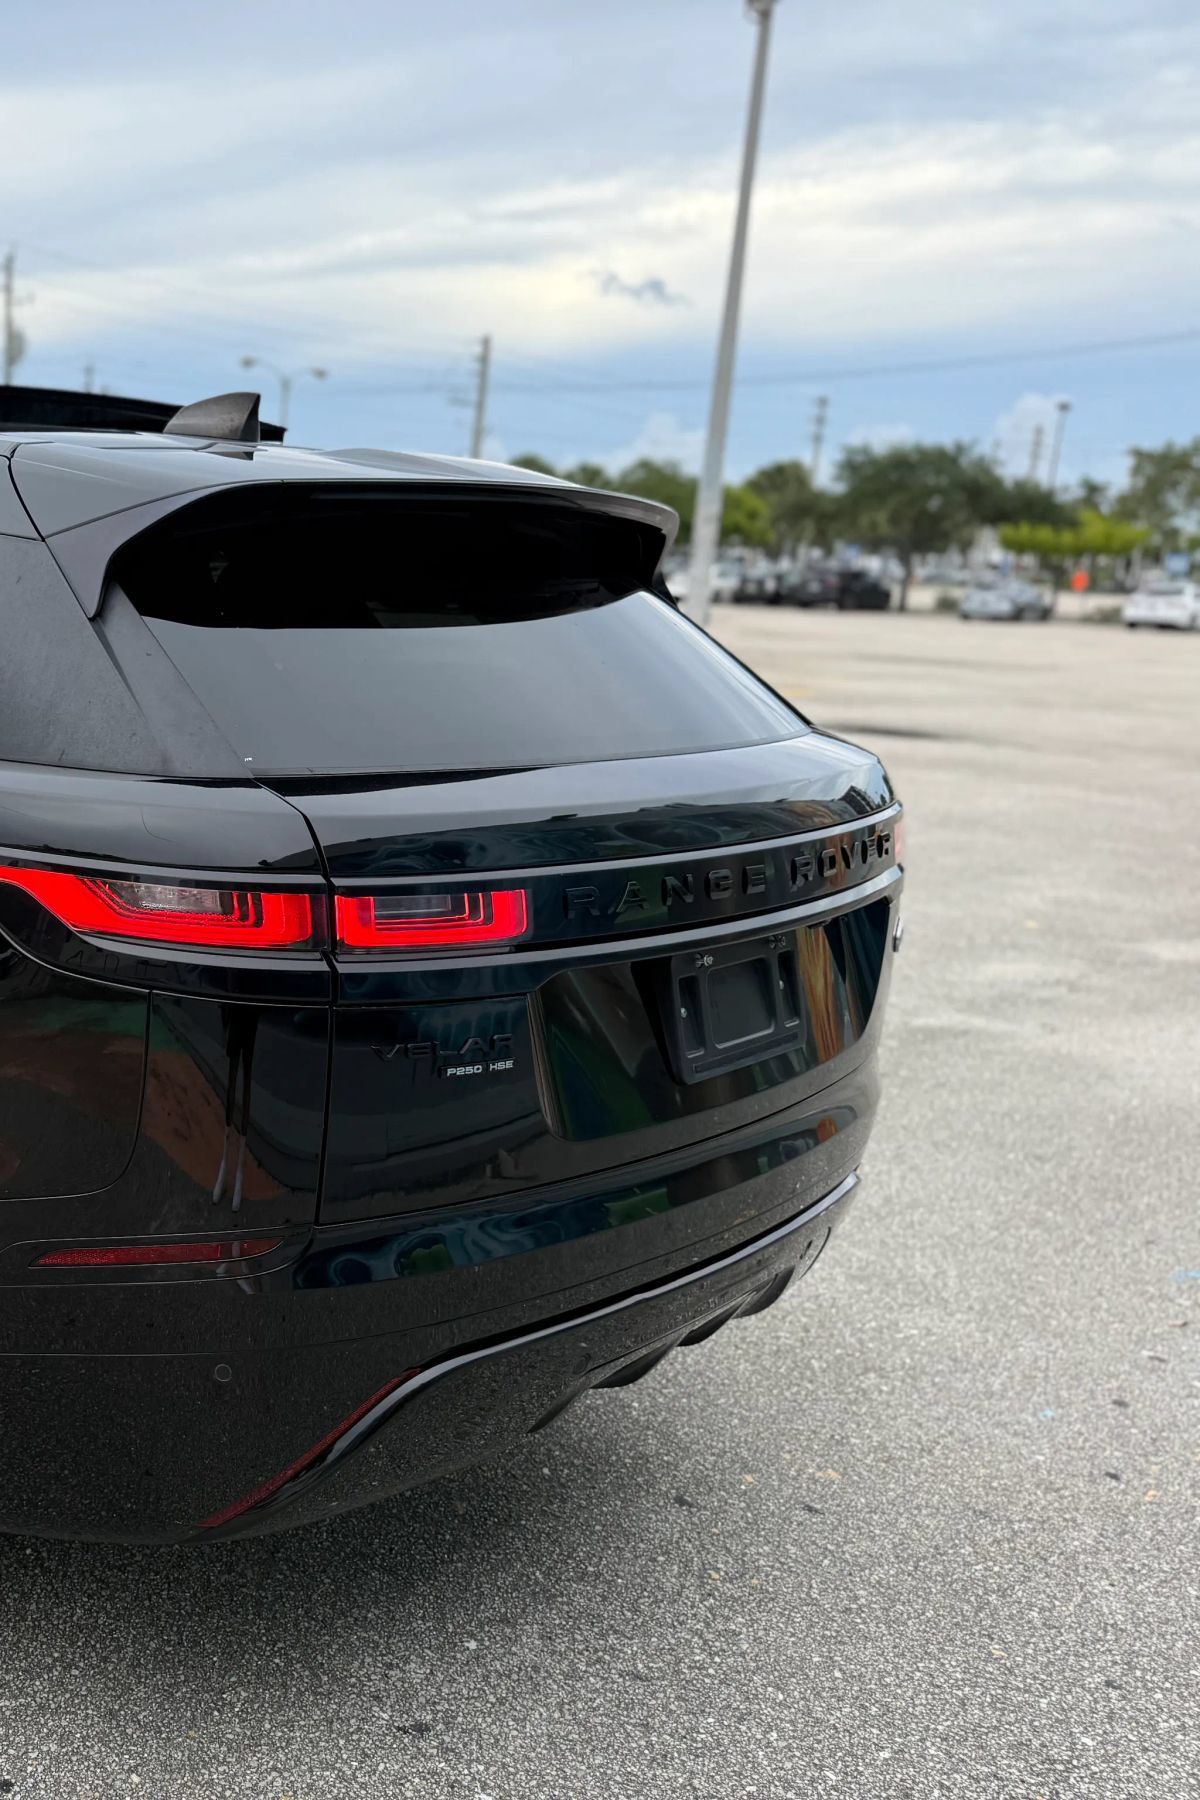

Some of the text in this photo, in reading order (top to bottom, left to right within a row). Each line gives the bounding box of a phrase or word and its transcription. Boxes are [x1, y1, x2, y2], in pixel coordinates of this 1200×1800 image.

[563, 831, 891, 919] RANGE ROVER
[369, 1033, 513, 1062] VELAR
[446, 1060, 515, 1077] P250 HSE
